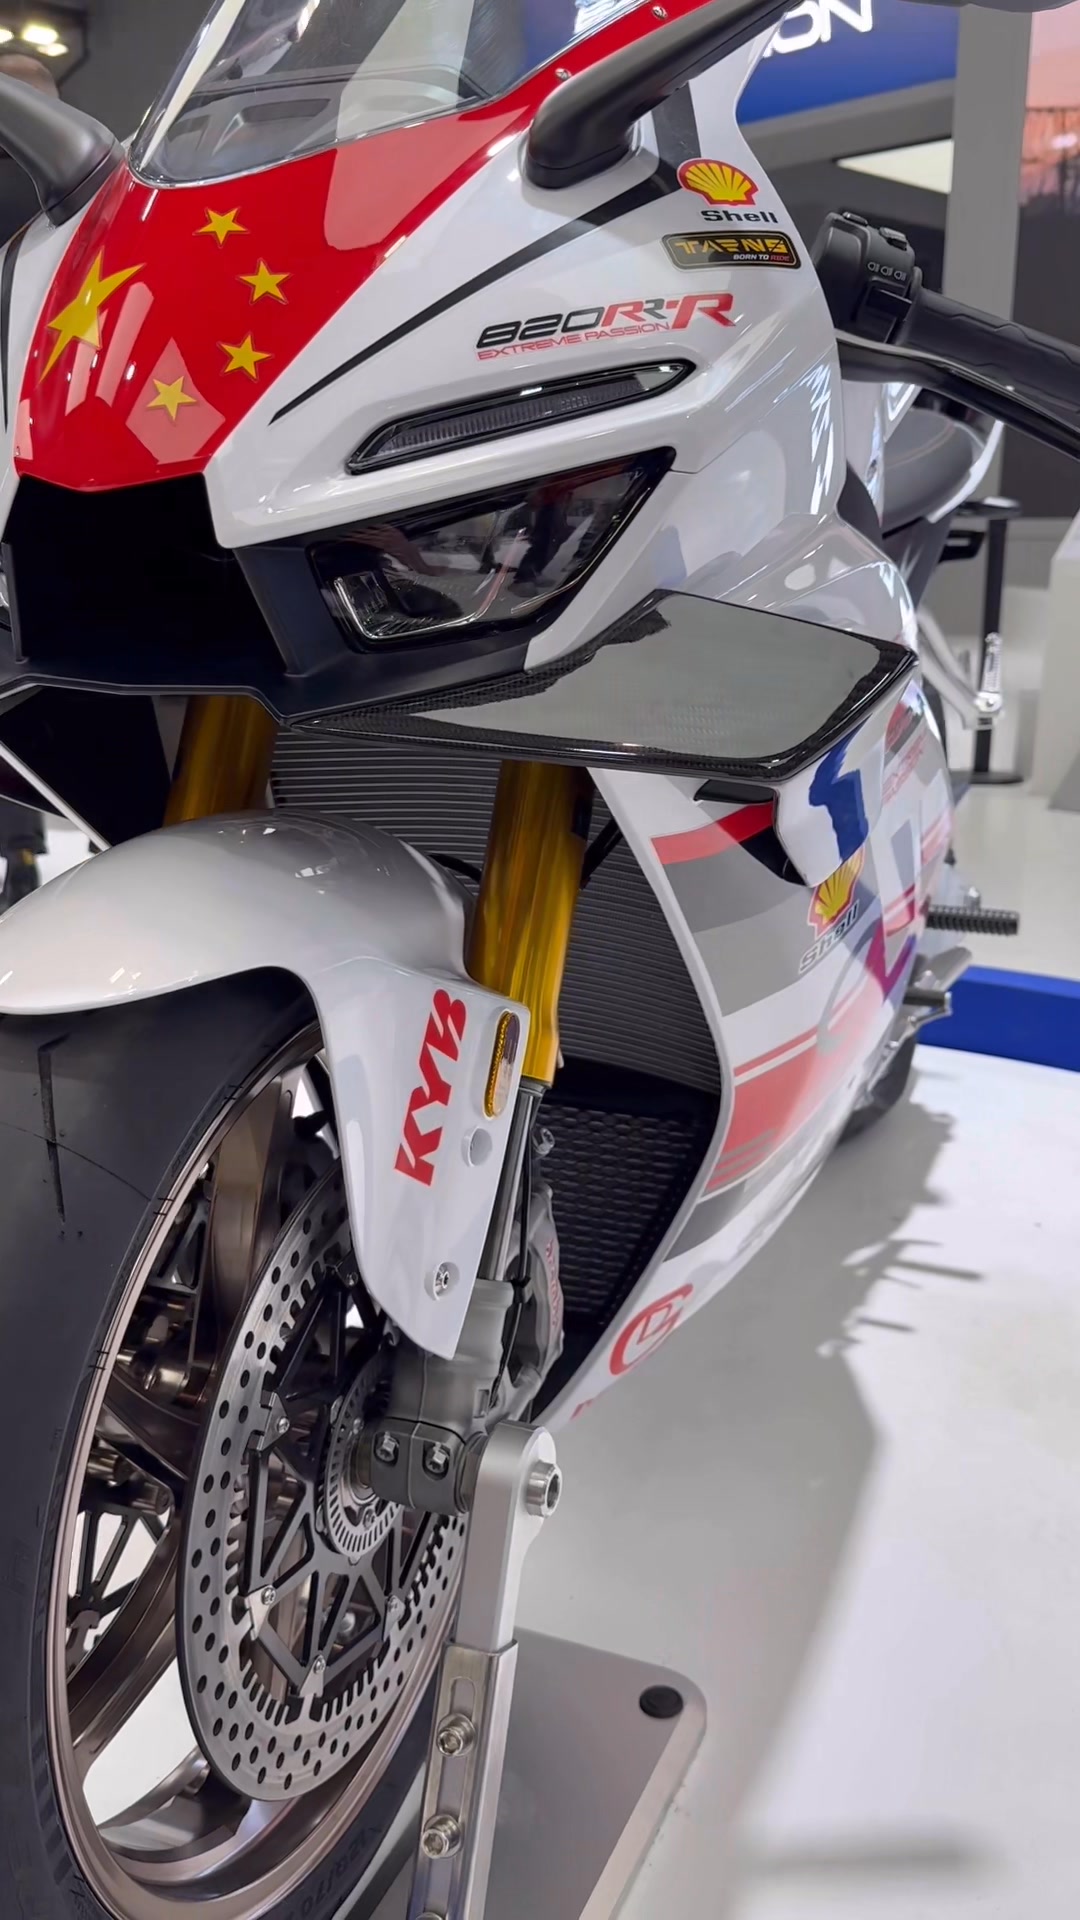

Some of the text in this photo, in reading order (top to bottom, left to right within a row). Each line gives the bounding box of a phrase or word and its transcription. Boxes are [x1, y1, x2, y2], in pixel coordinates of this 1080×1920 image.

[762, 0, 873, 58] ON
[701, 210, 779, 223] Shell
[477, 321, 669, 361] EXTREME PASSION
[799, 903, 859, 973] Shell
[394, 988, 467, 1186] KYB
